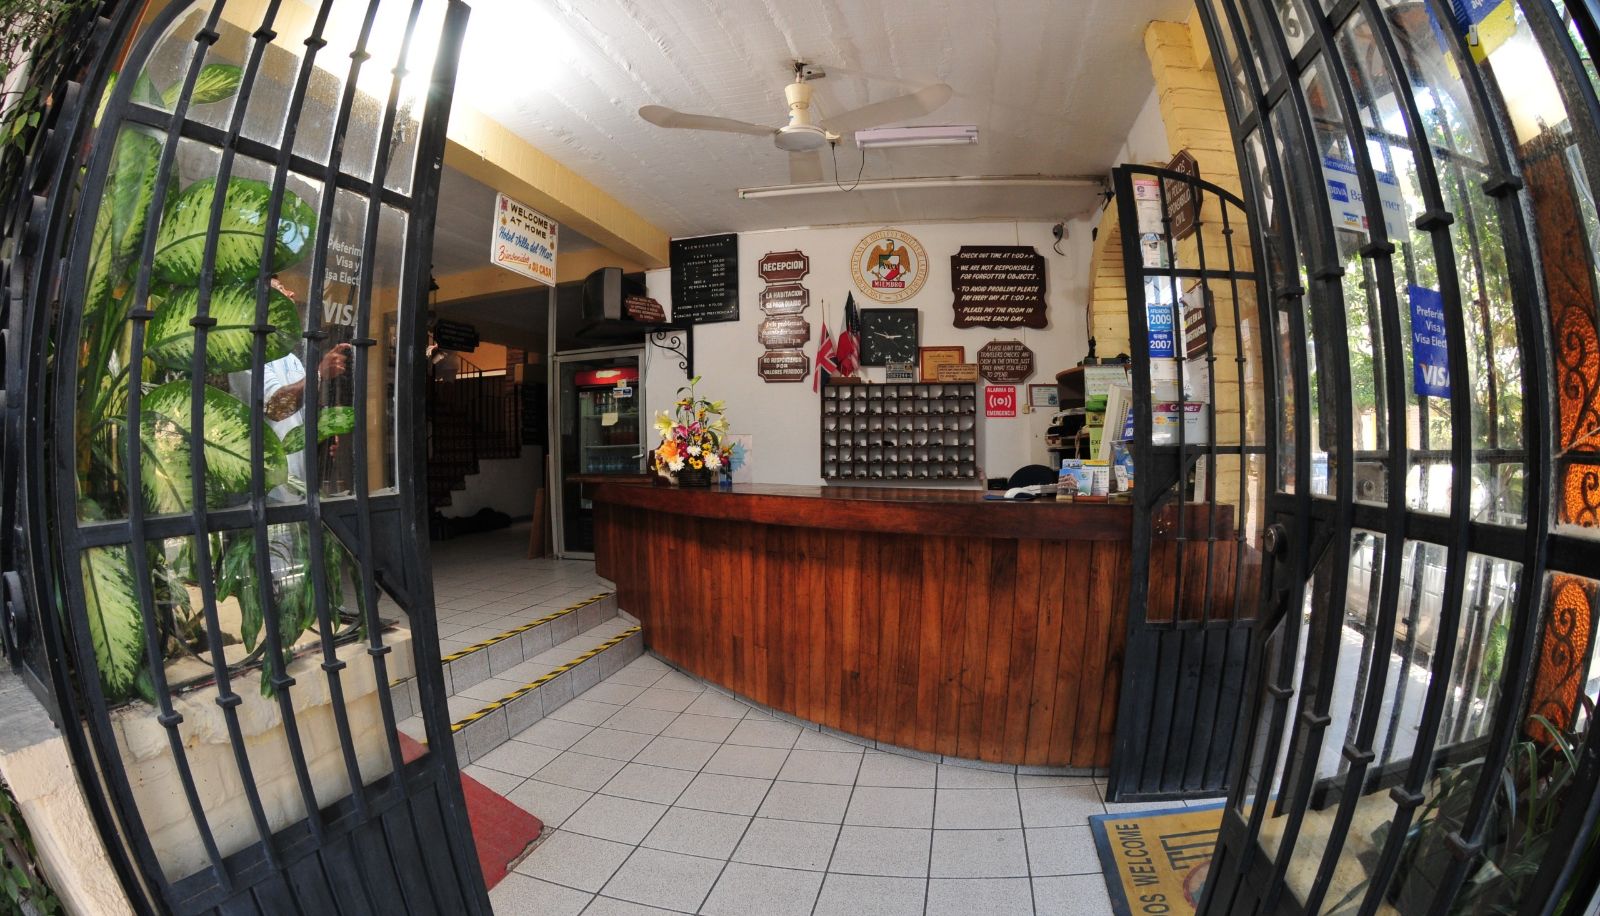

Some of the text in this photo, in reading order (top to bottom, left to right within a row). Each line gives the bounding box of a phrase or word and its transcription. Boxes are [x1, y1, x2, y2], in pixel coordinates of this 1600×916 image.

[511, 203, 548, 230] WELCOME
[510, 216, 547, 239] AT HOME
[499, 226, 553, 261] Hotel Villa del Mar
[336, 254, 353, 269] Visa
[763, 260, 804, 272] RECEPCION
[325, 268, 338, 281] isa
[532, 262, 540, 272] SU
[540, 265, 552, 278] CASA
[773, 290, 803, 299] HABITACION
[1150, 315, 1171, 325] 2009
[1425, 320, 1441, 333] Visa
[1150, 340, 1172, 349] 2007
[1415, 332, 1431, 345] Visa
[1115, 823, 1160, 887] WELCOME
